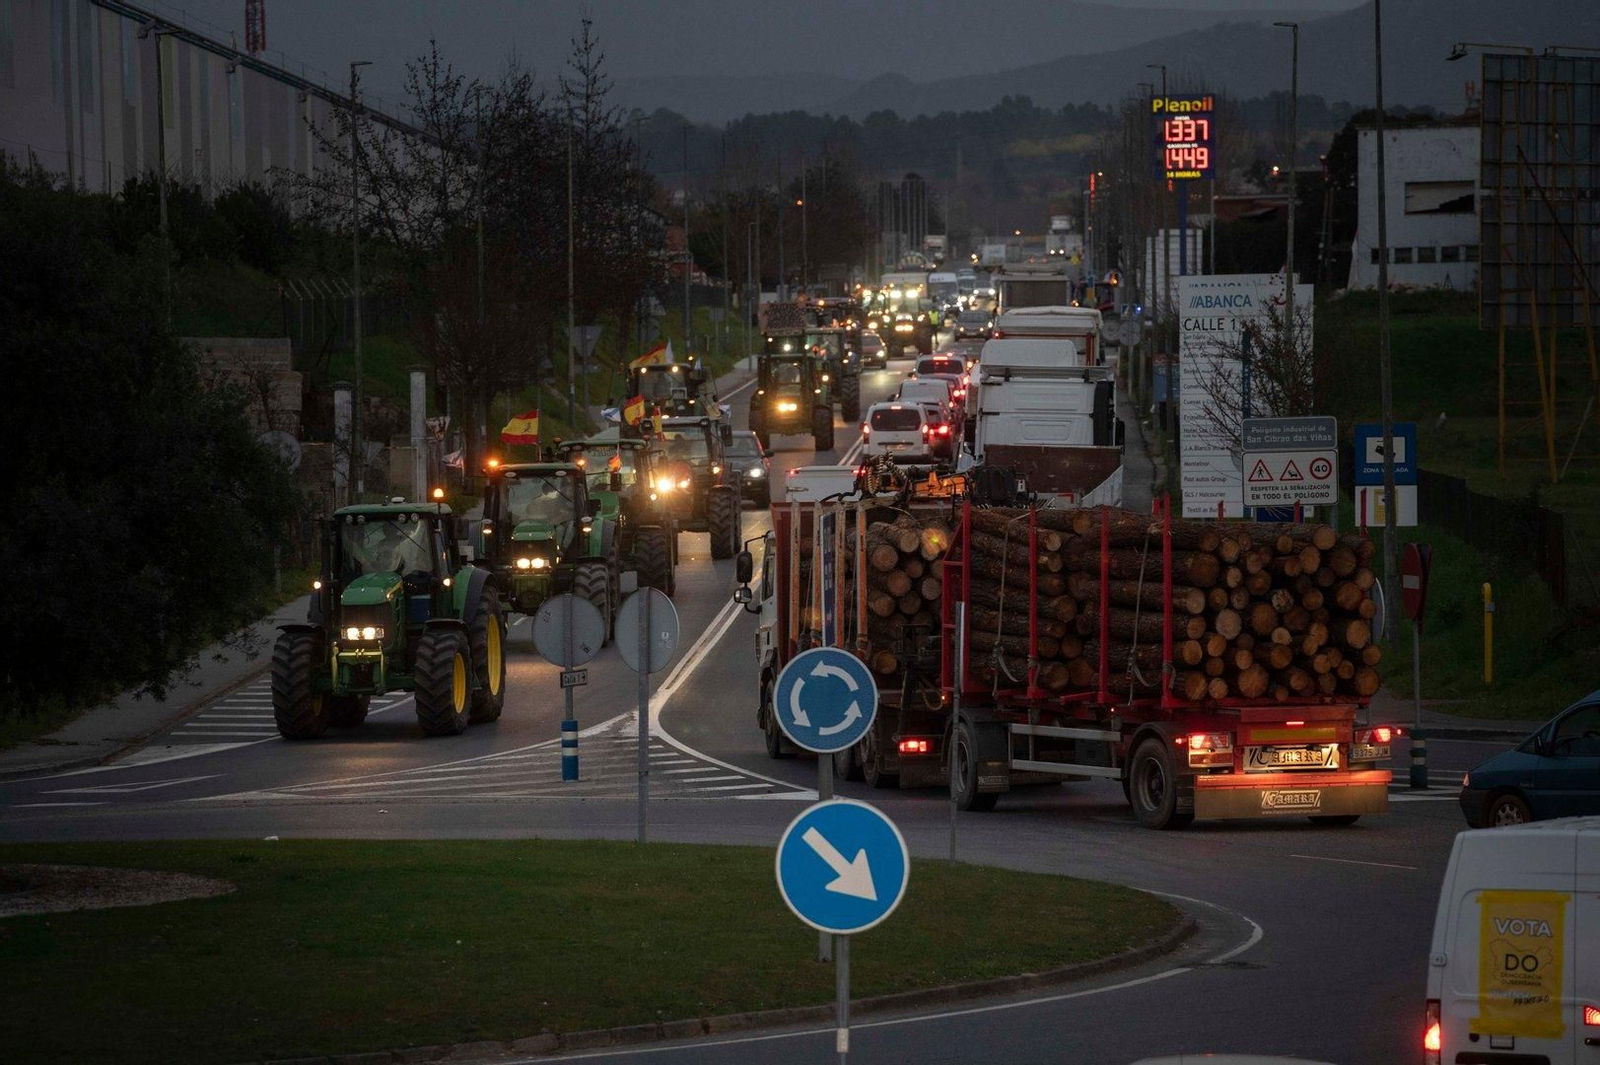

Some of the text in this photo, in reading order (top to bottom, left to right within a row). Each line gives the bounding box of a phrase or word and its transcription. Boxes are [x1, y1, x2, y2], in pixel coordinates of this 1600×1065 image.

[1152, 97, 1213, 113] Plenoil
[1183, 318, 1225, 331] CALLE
[1283, 425, 1315, 433] industrial
[1246, 435, 1262, 443] San
[1264, 434, 1290, 443] Cibrao
[1310, 433, 1332, 442] Viñas
[1314, 464, 1328, 473] 40
[1289, 483, 1331, 491] SEÑALIZACIÓN
[1294, 491, 1330, 499] POLÍGONO
[1494, 917, 1553, 938] VOTA
[1505, 954, 1538, 972] DO
[1500, 972, 1542, 980] DEMOCRACIA
